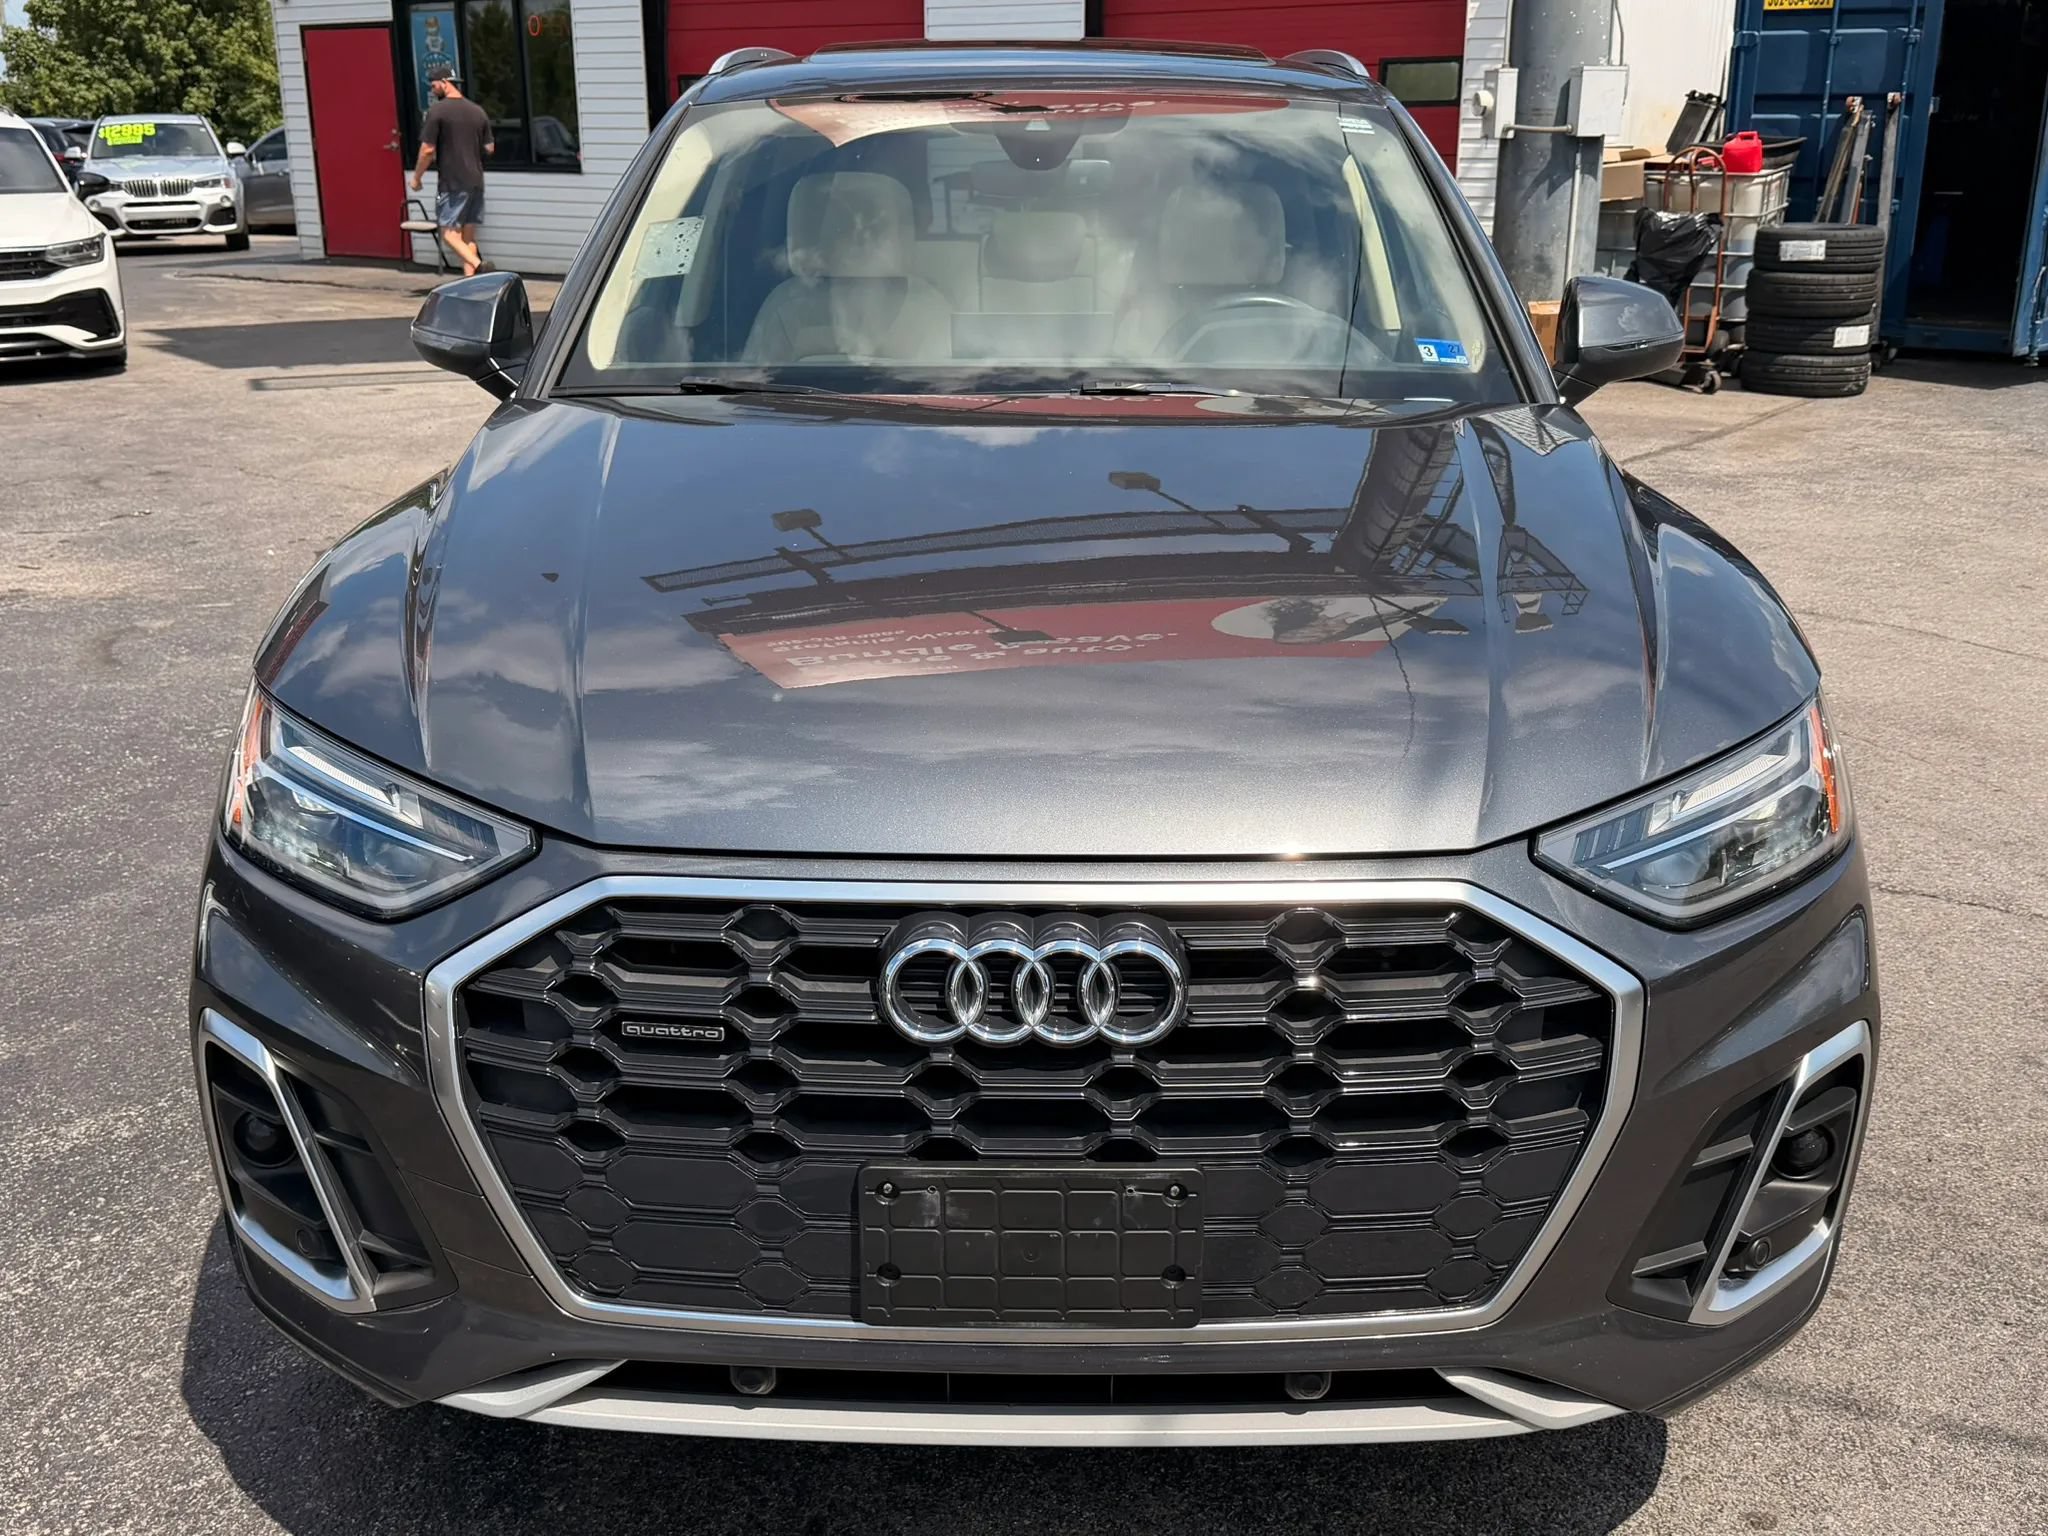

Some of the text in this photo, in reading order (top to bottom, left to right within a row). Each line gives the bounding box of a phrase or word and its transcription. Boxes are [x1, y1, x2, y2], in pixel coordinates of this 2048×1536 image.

[1424, 346, 1433, 357] 3
[1448, 344, 1460, 354] 27
[626, 1025, 719, 1038] quattro
